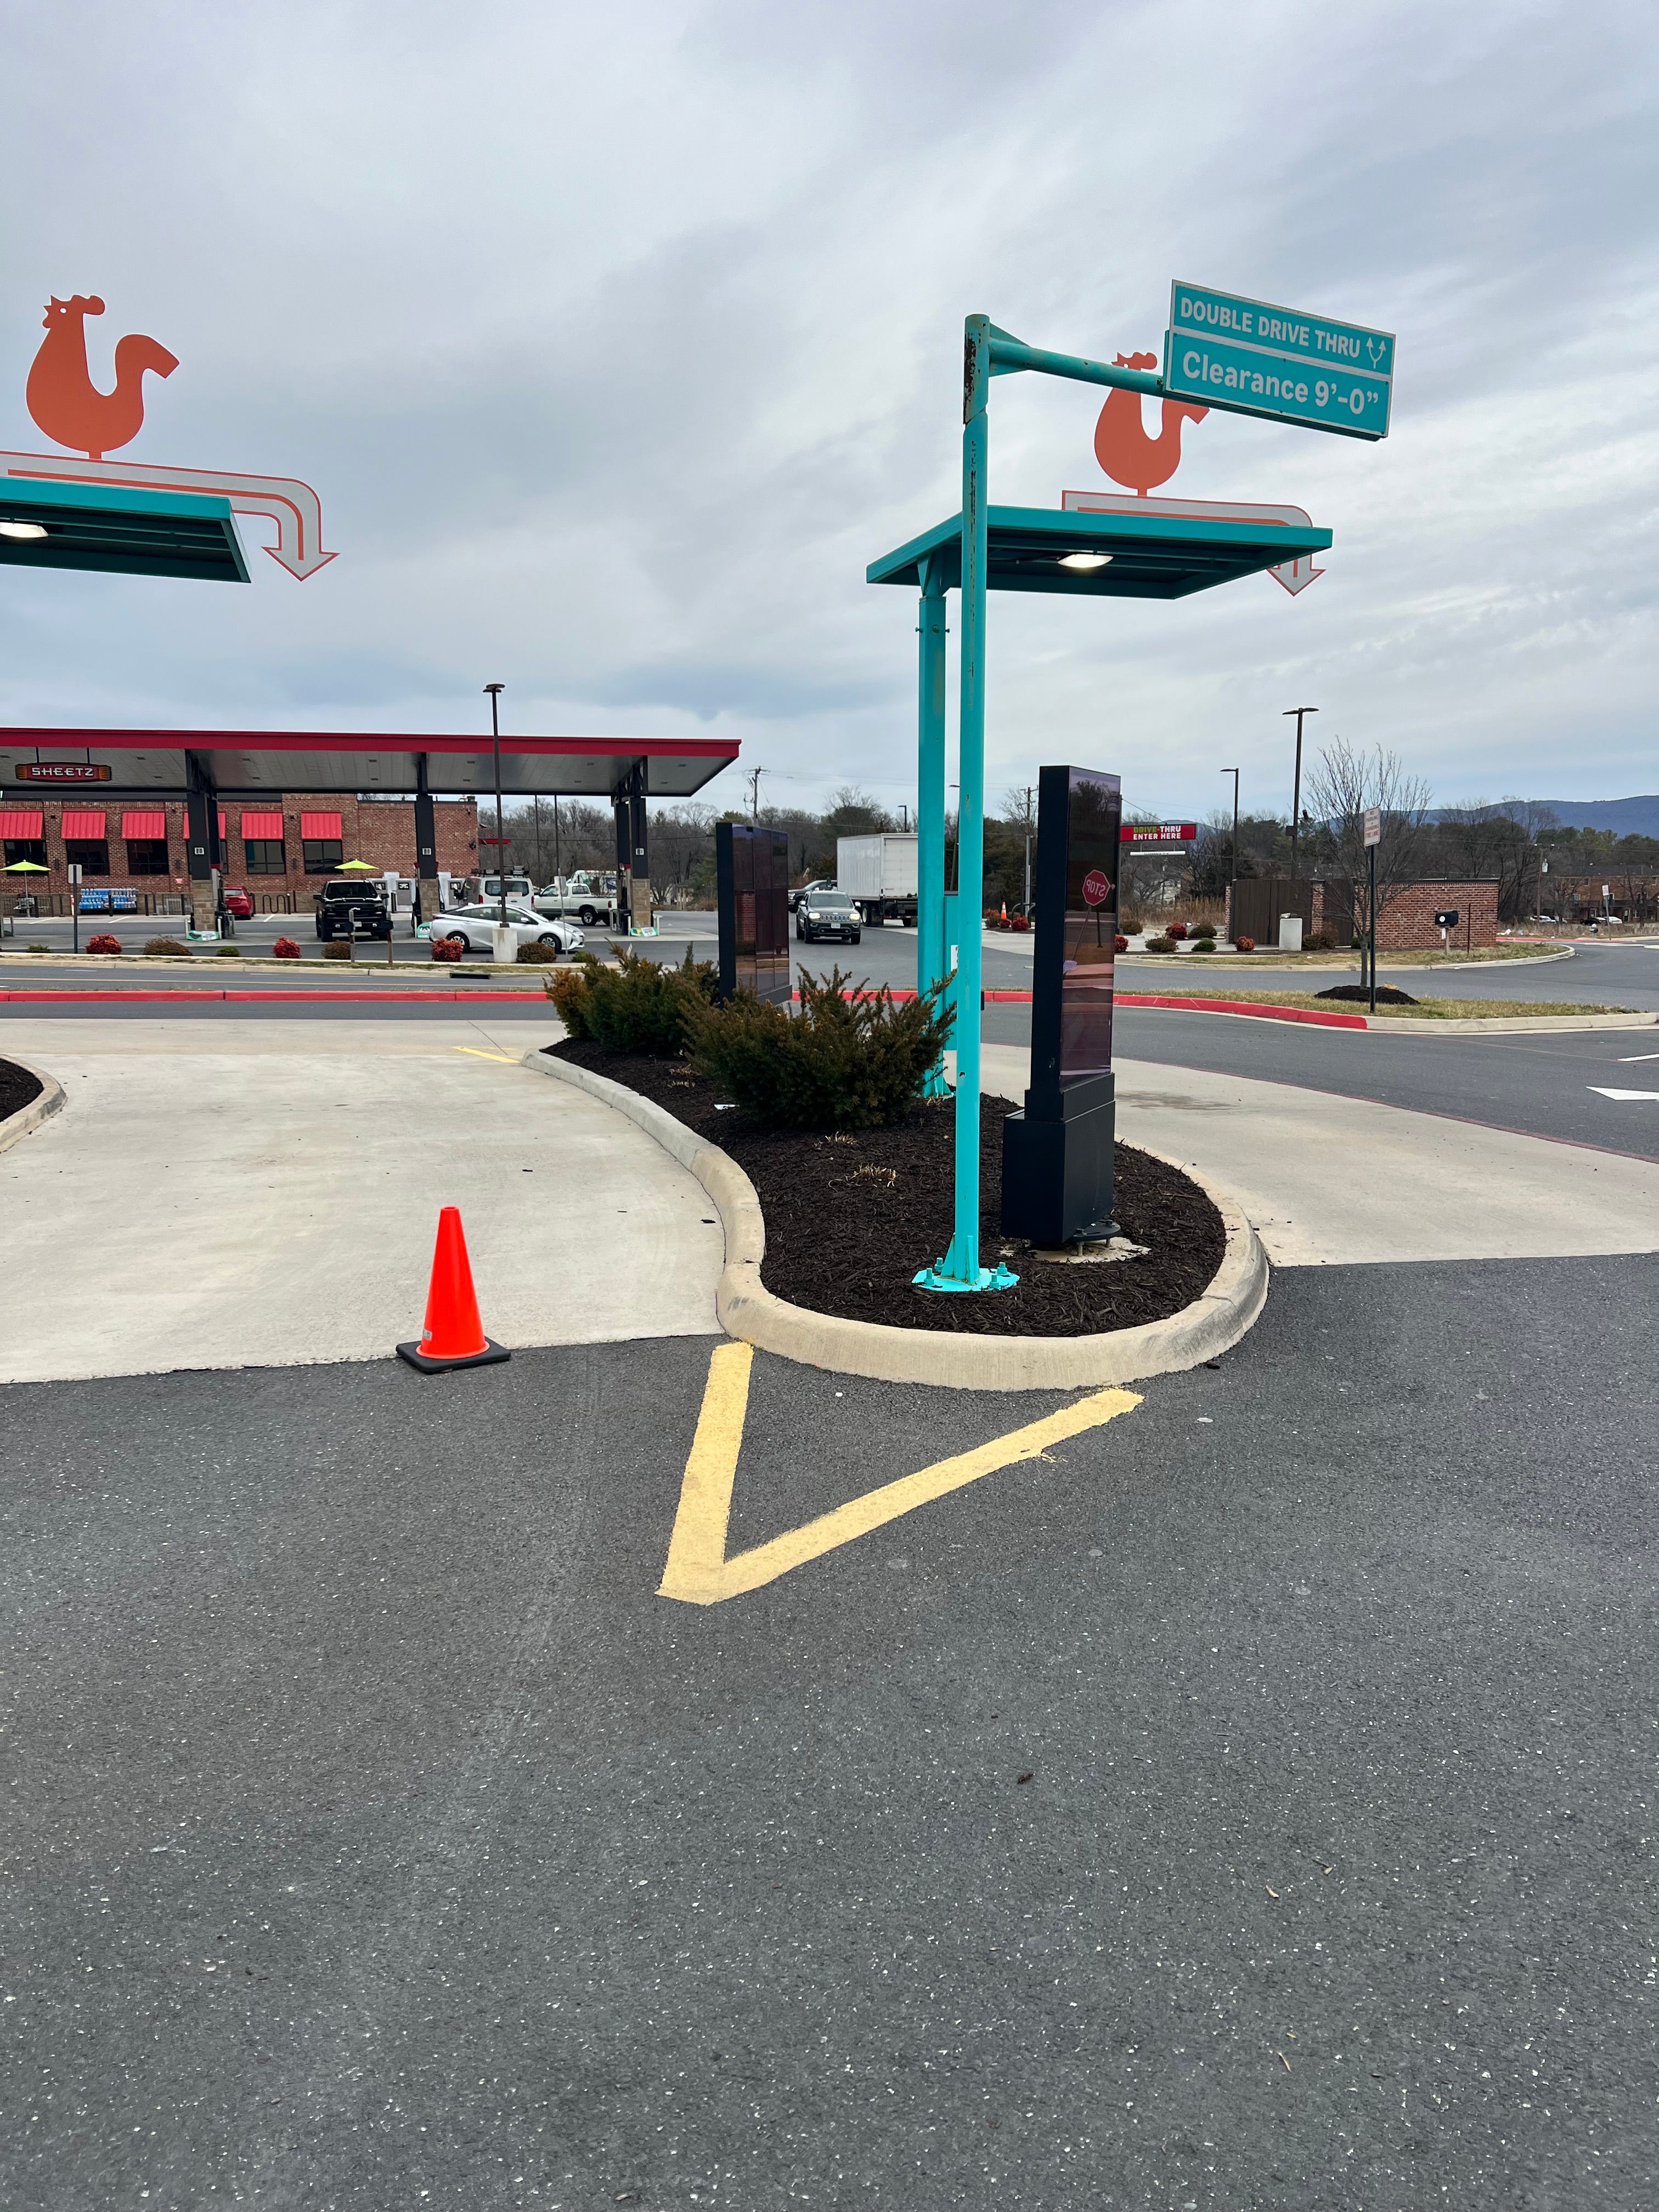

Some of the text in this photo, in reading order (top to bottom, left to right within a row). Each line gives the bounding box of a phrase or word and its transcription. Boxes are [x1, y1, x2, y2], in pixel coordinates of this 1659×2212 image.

[1181, 297, 1361, 358] DOUBLE DRIVE THRU
[1182, 351, 1308, 403] Clearance
[32, 767, 94, 776] SHEETZ
